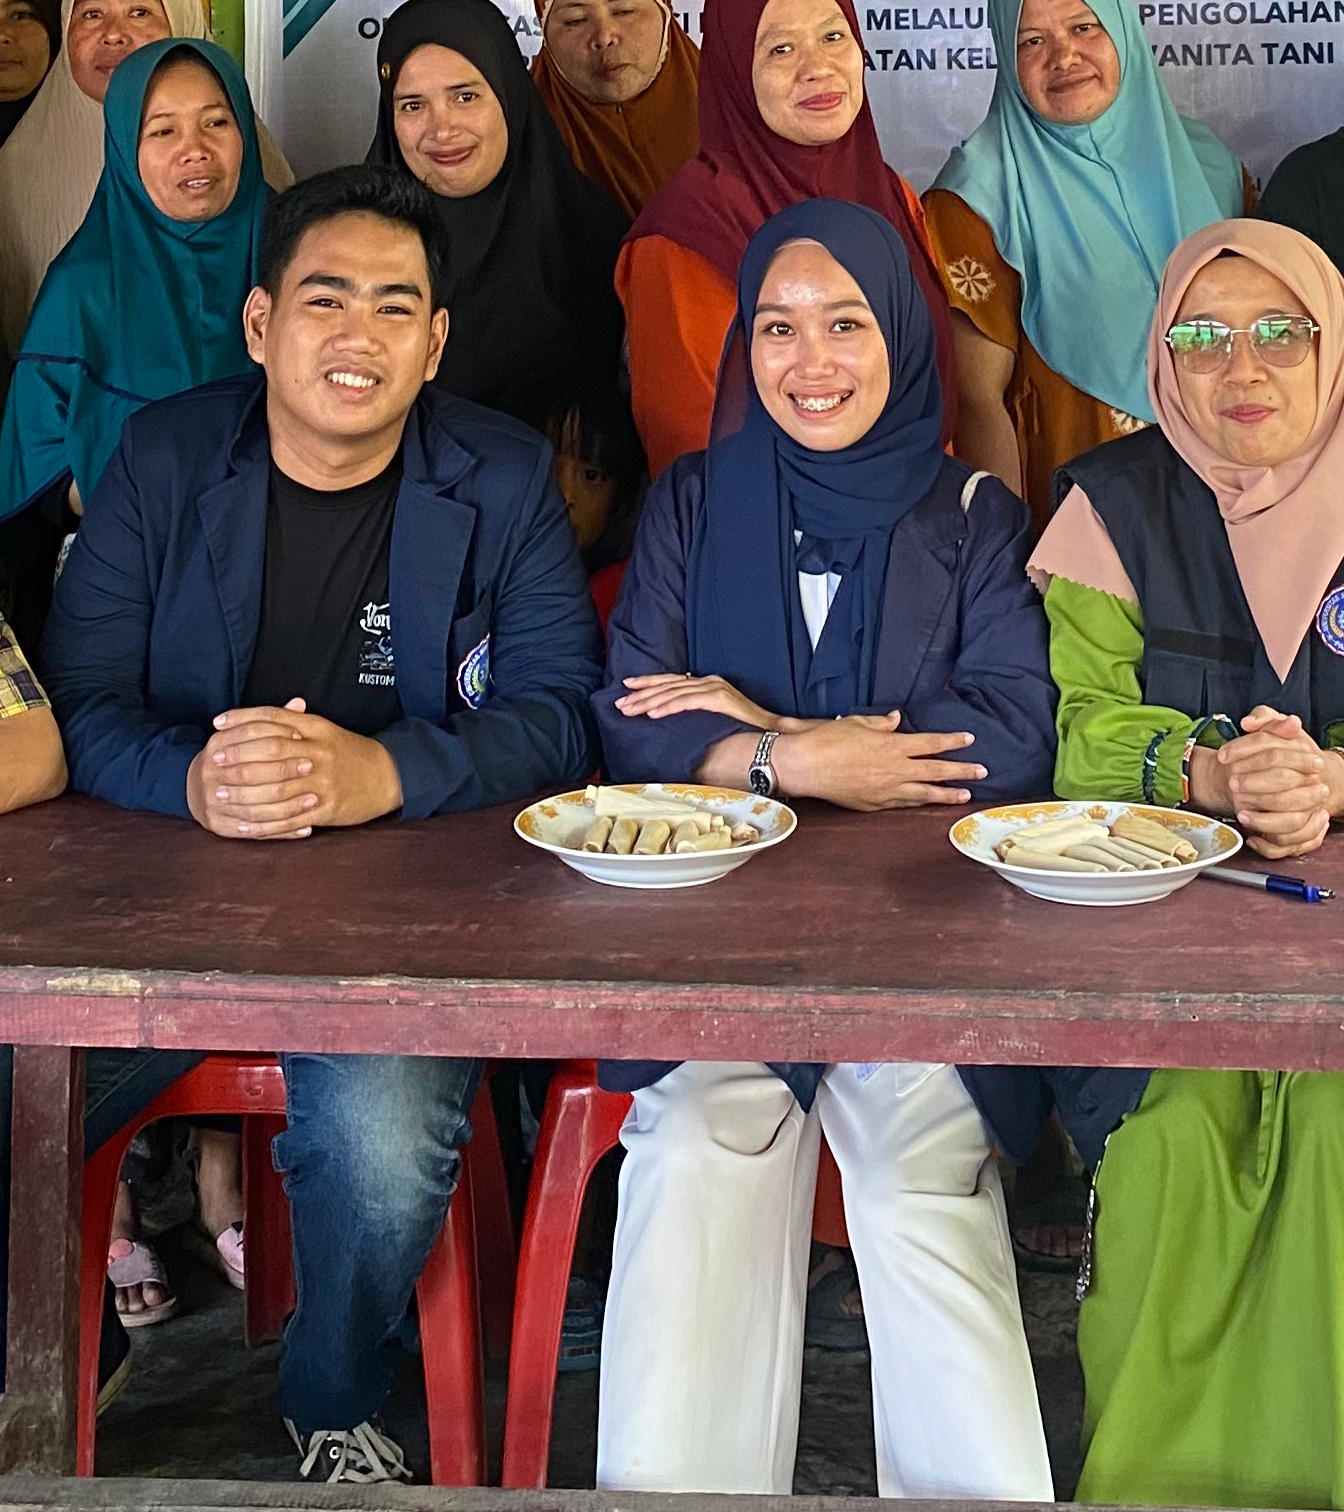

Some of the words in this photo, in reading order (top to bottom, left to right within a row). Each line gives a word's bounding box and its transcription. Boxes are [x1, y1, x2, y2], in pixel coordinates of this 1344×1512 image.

[866, 7, 991, 31] MELALU
[864, 48, 937, 71] ATAN
[1152, 42, 1255, 67] ANITA
[1261, 41, 1334, 65] TANI
[358, 673, 394, 686] KUSTOM
